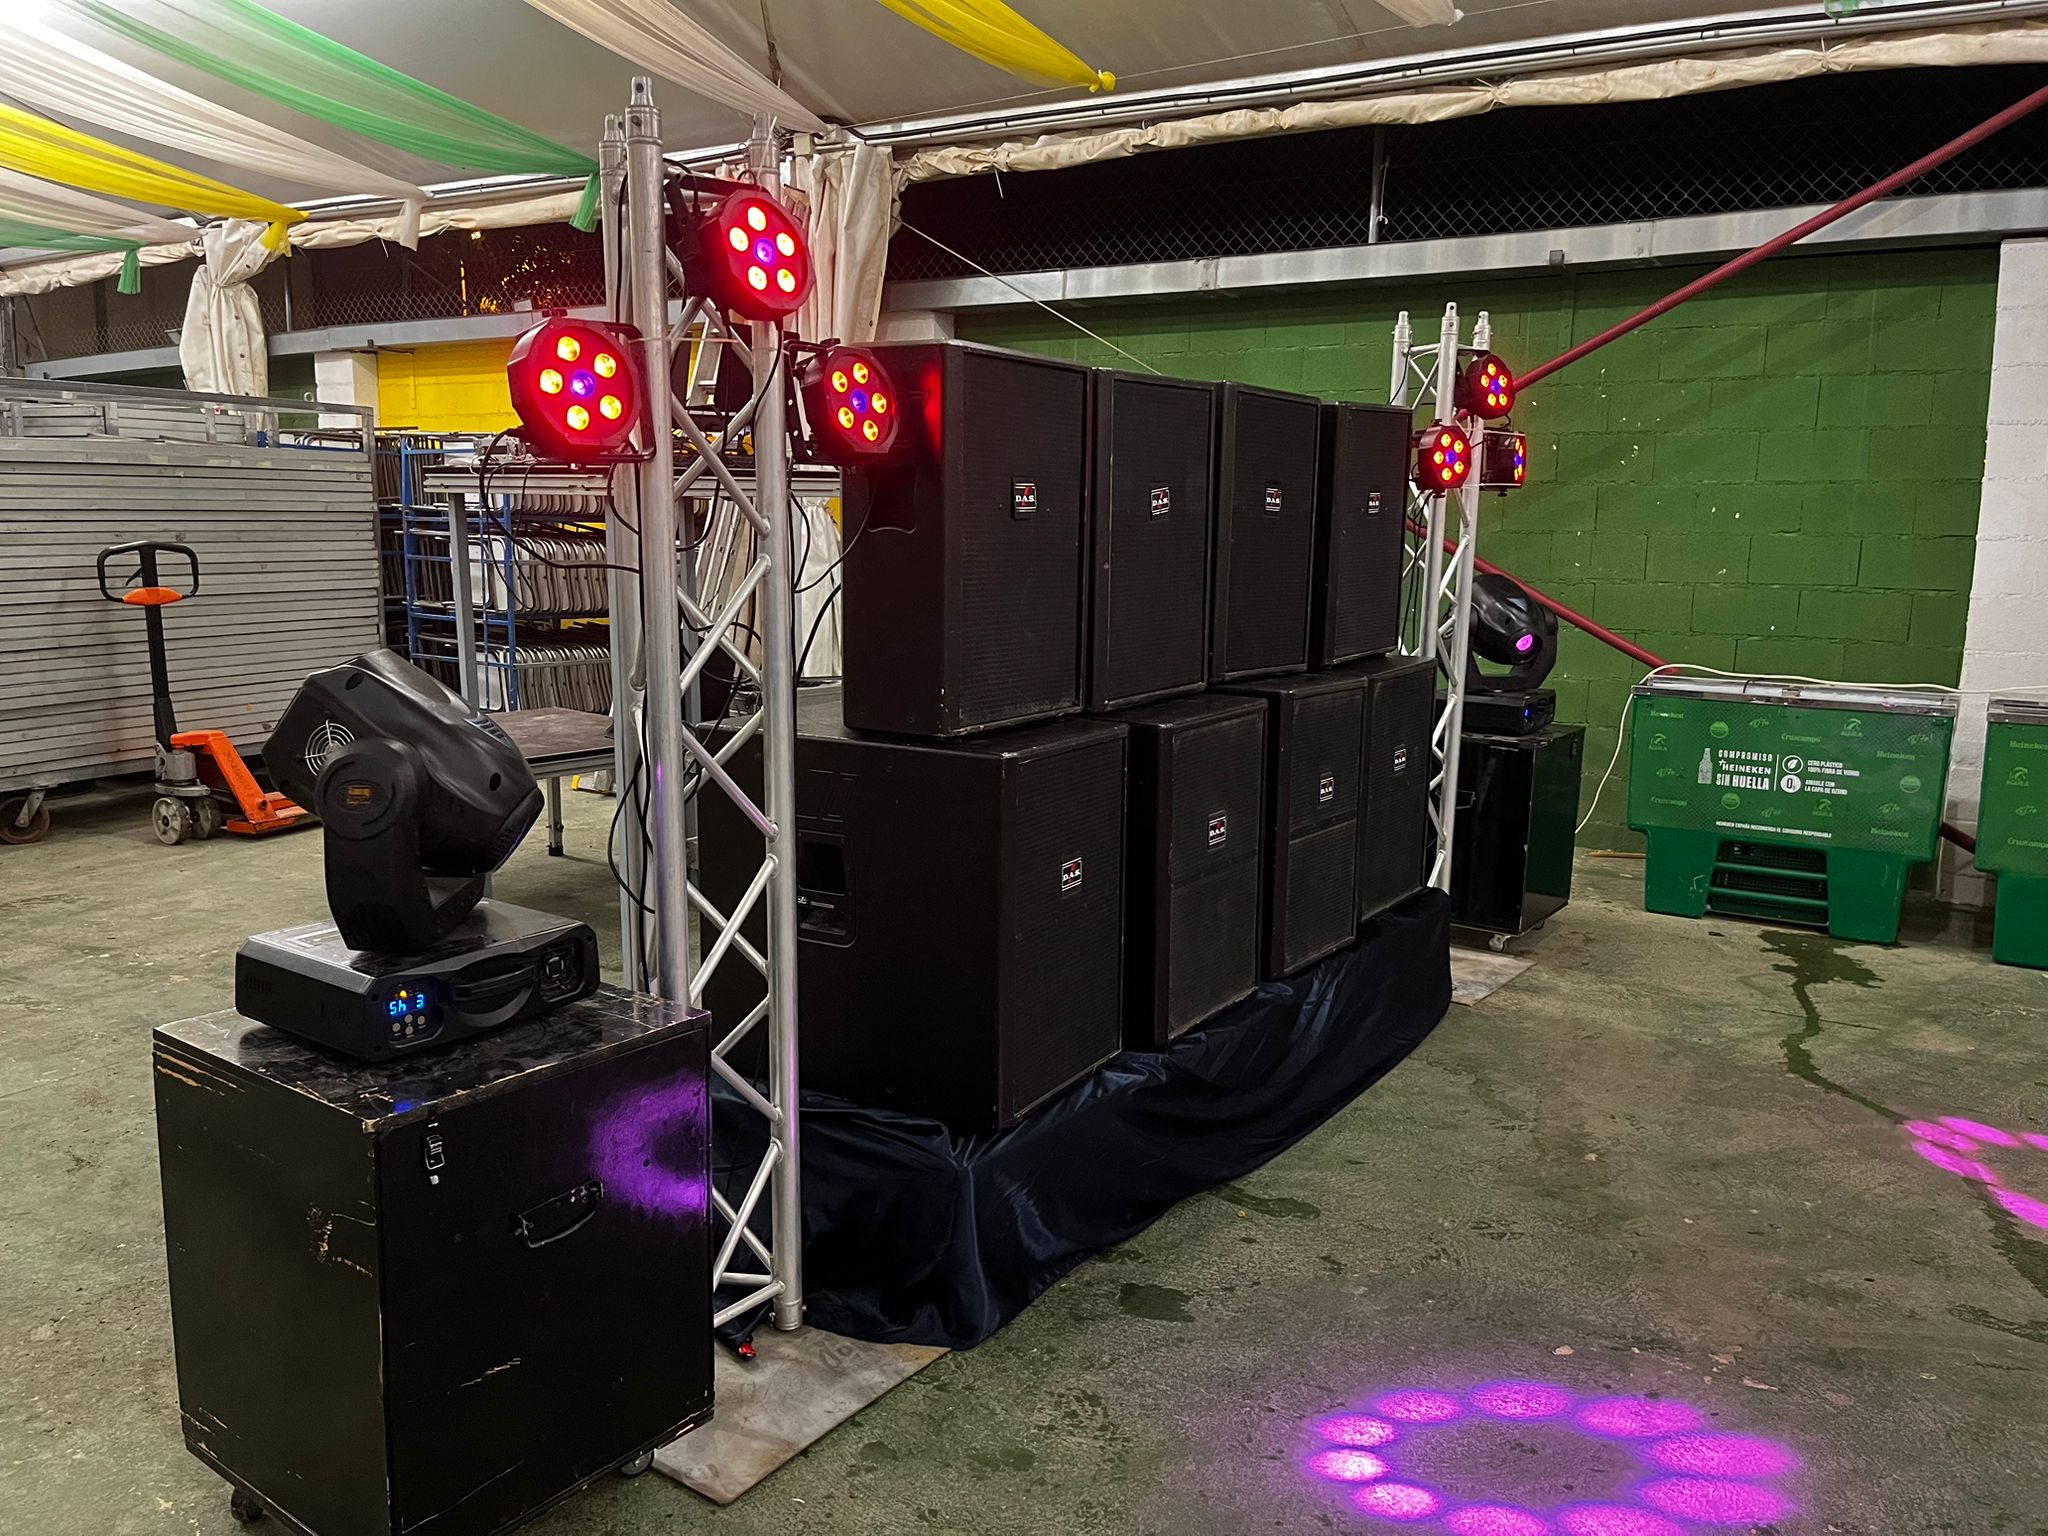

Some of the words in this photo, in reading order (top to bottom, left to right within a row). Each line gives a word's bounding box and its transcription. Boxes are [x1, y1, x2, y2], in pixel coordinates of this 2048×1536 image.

[1718, 749, 1773, 762] COMPROMISO
[1722, 763, 1771, 775] HEINEKEN
[1716, 773, 1730, 786] SIN
[1732, 774, 1769, 791] HUELLA
[416, 993, 424, 1008] 3
